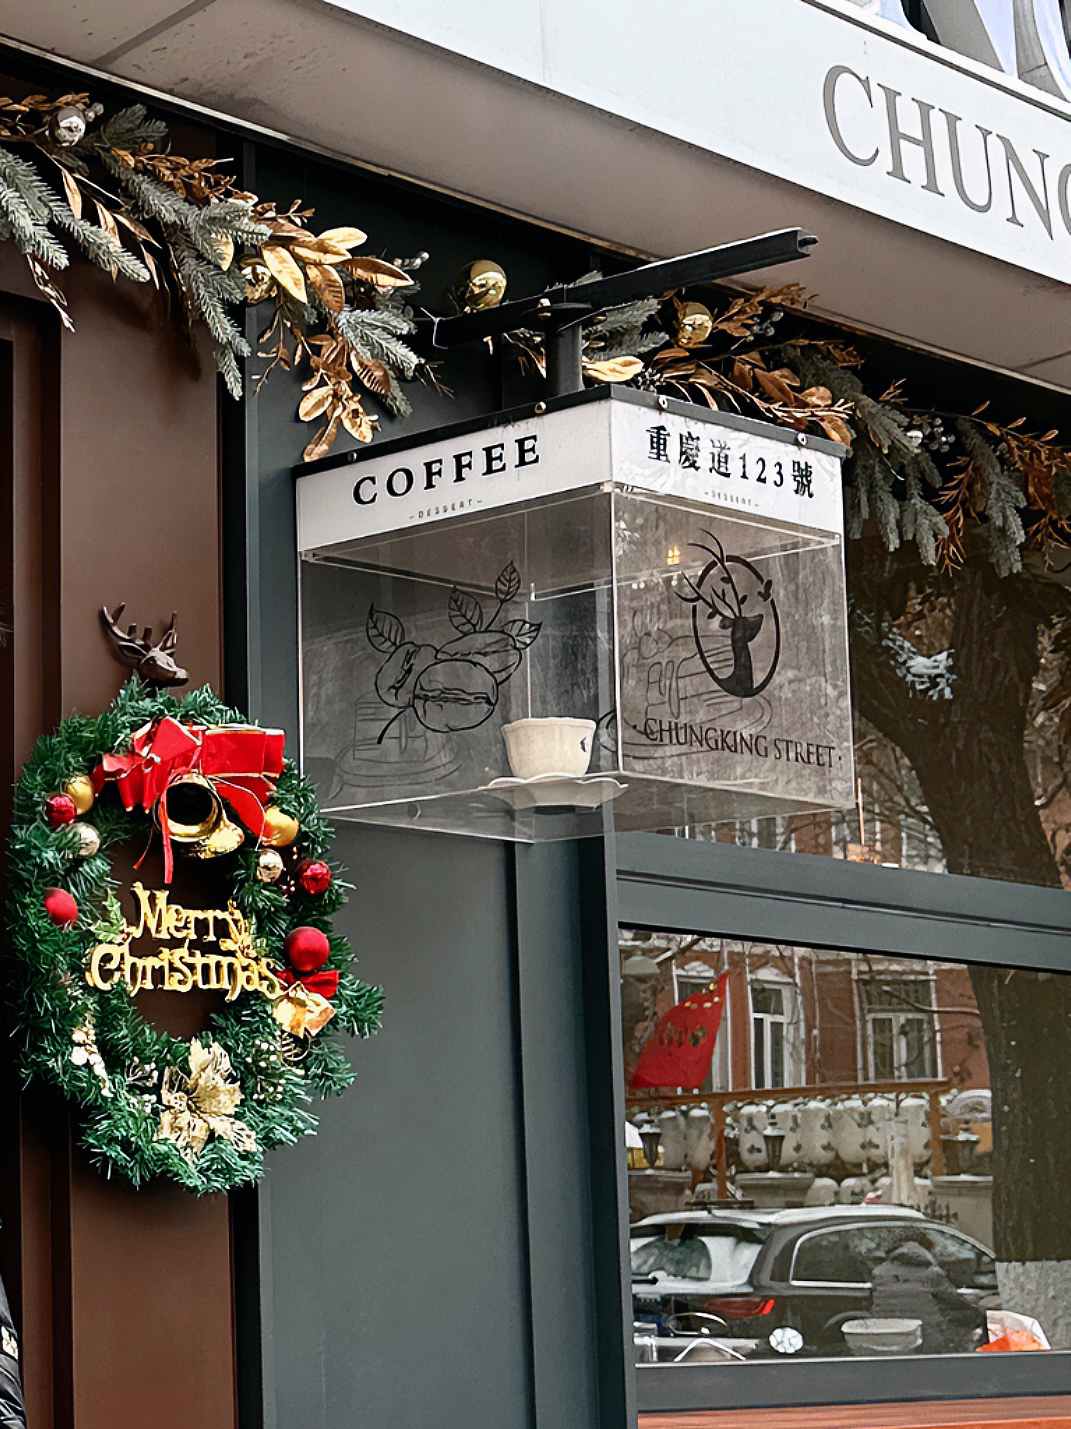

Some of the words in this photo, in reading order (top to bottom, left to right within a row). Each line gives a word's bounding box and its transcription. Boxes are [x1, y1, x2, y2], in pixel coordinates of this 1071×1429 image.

[822, 65, 1071, 241] CHUN
[352, 434, 540, 505] COFFEE
[645, 425, 815, 499] 重慶道123號
[643, 717, 769, 758] CHUNGKING
[774, 737, 836, 768] STREET
[131, 881, 246, 951] Merry
[86, 937, 283, 1003] Christmas
